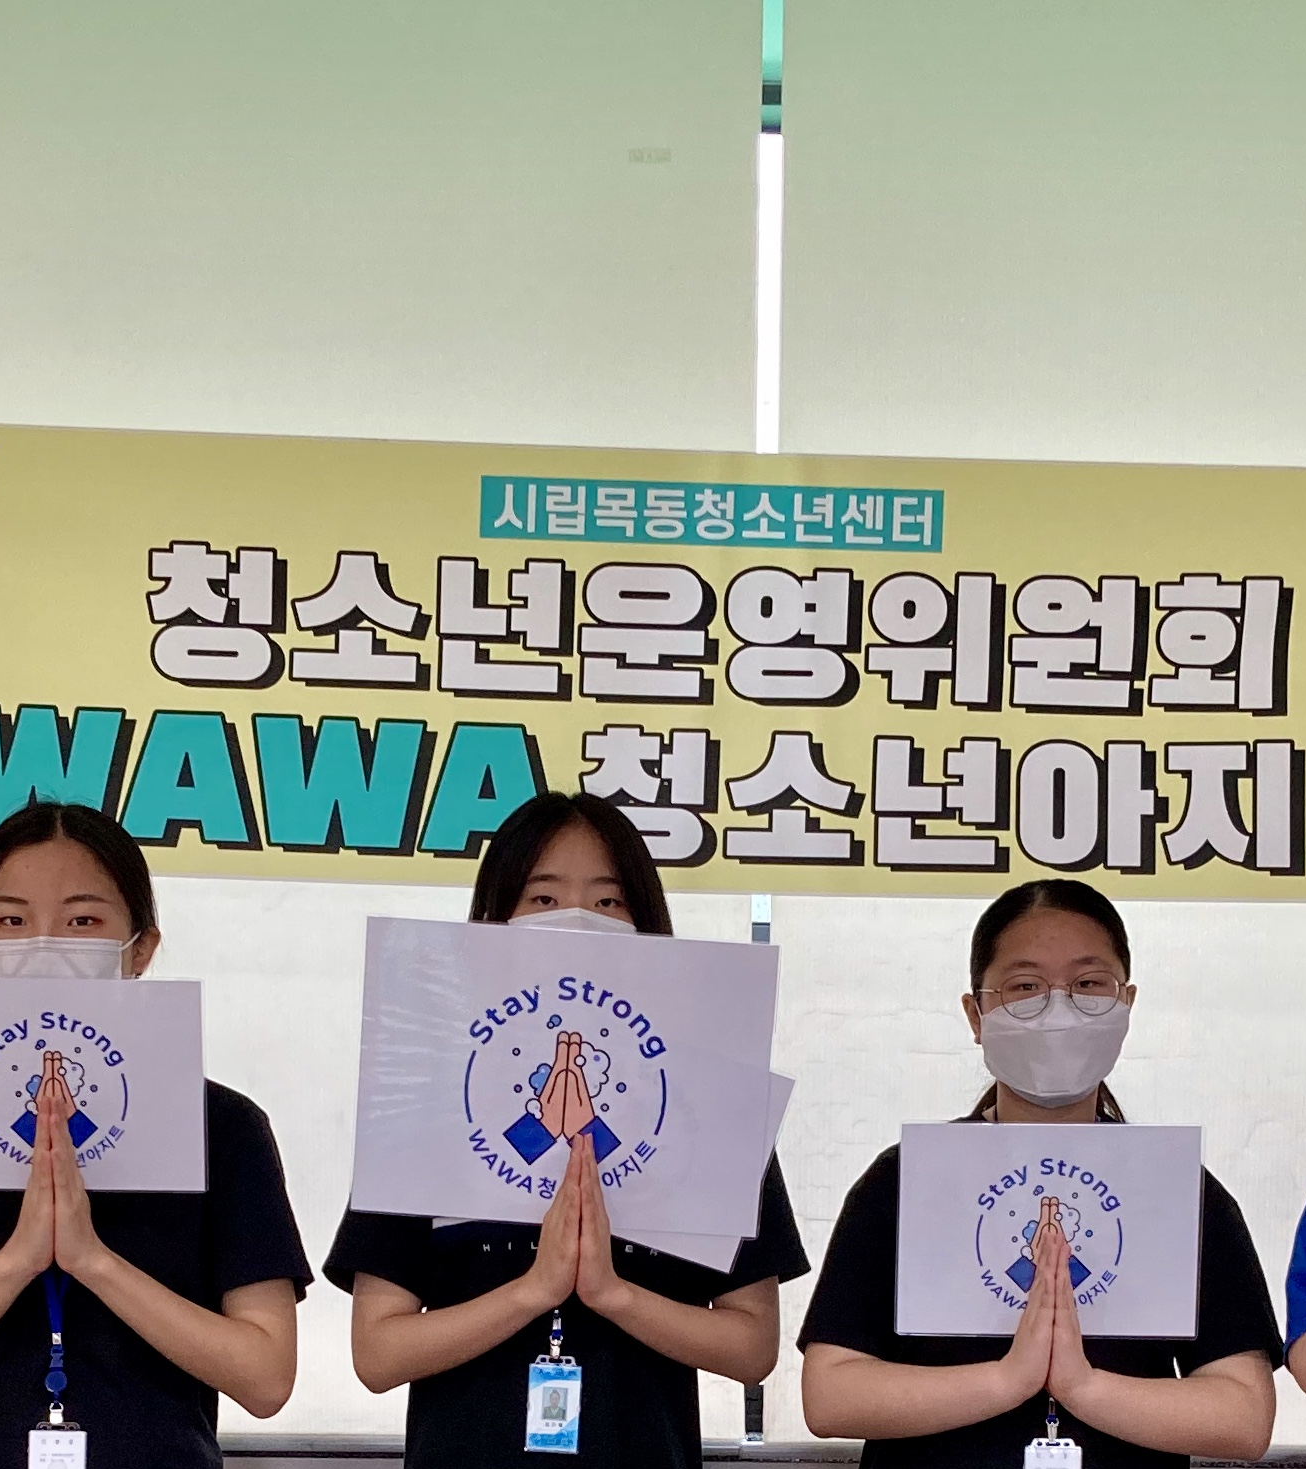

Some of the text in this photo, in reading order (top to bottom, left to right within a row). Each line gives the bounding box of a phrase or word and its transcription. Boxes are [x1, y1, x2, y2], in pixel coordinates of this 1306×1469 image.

[494, 483, 933, 546] 시립목동청소년센터
[147, 540, 1292, 718] 청소년운영위원회
[41, 1012, 125, 1067] Strong
[469, 976, 667, 1059] Stay Strong
[469, 1128, 657, 1200] WAWA청아지트
[978, 1158, 1121, 1213] Stay Strong
